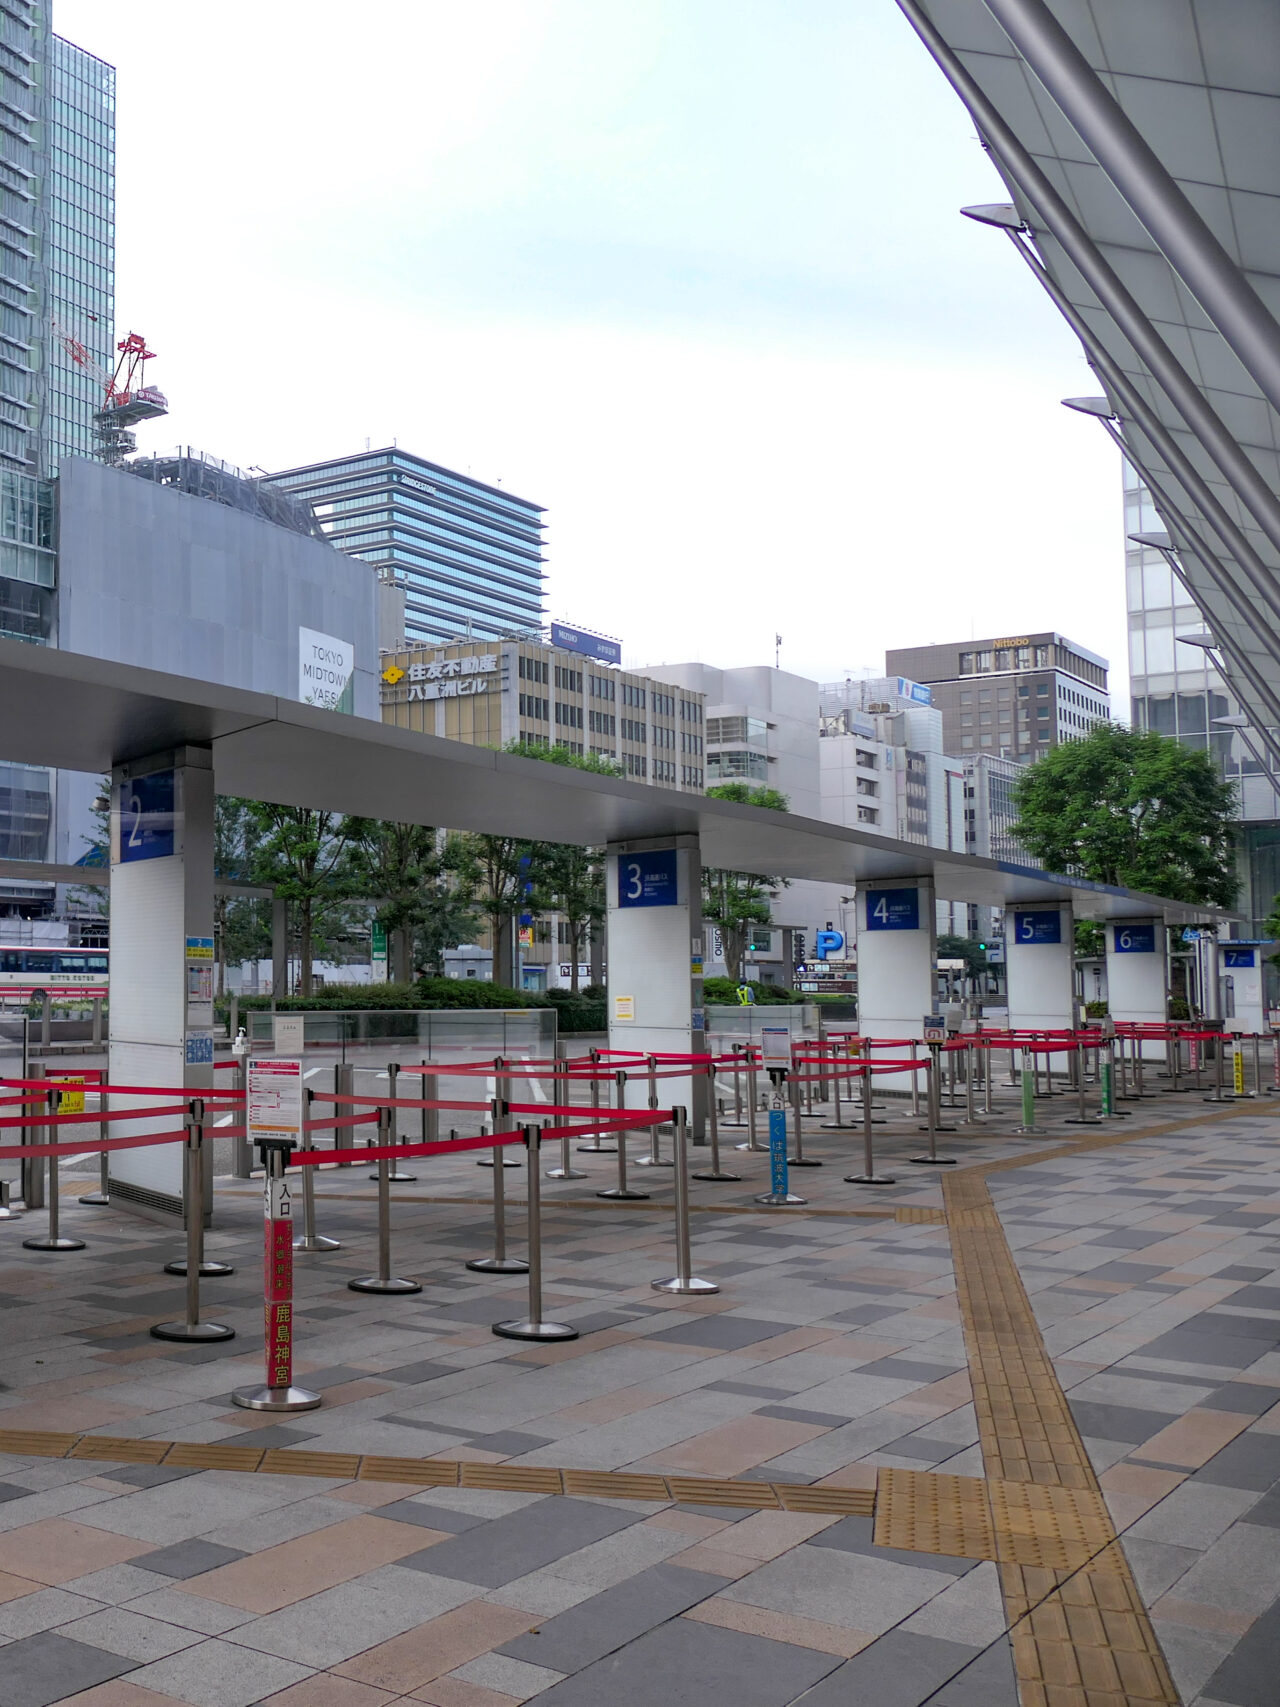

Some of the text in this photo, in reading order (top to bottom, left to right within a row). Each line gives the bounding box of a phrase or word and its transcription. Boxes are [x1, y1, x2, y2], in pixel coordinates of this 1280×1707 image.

[992, 637, 1030, 648] Nittobo
[312, 644, 344, 667] TOKYO
[407, 653, 498, 682] 住友不動産
[311, 686, 340, 705] YAES
[407, 677, 488, 702] 八重洲ビル
[128, 794, 142, 848] 2
[627, 863, 642, 899] 3
[873, 897, 889, 923] 4
[1021, 917, 1034, 939] 5
[1120, 930, 1132, 949] 6
[817, 930, 844, 961] P
[1228, 952, 1237, 965] 7
[772, 1092, 783, 1109] 入口
[279, 1183, 291, 1217] 入口
[275, 1303, 291, 1385] 鹿島神宮
